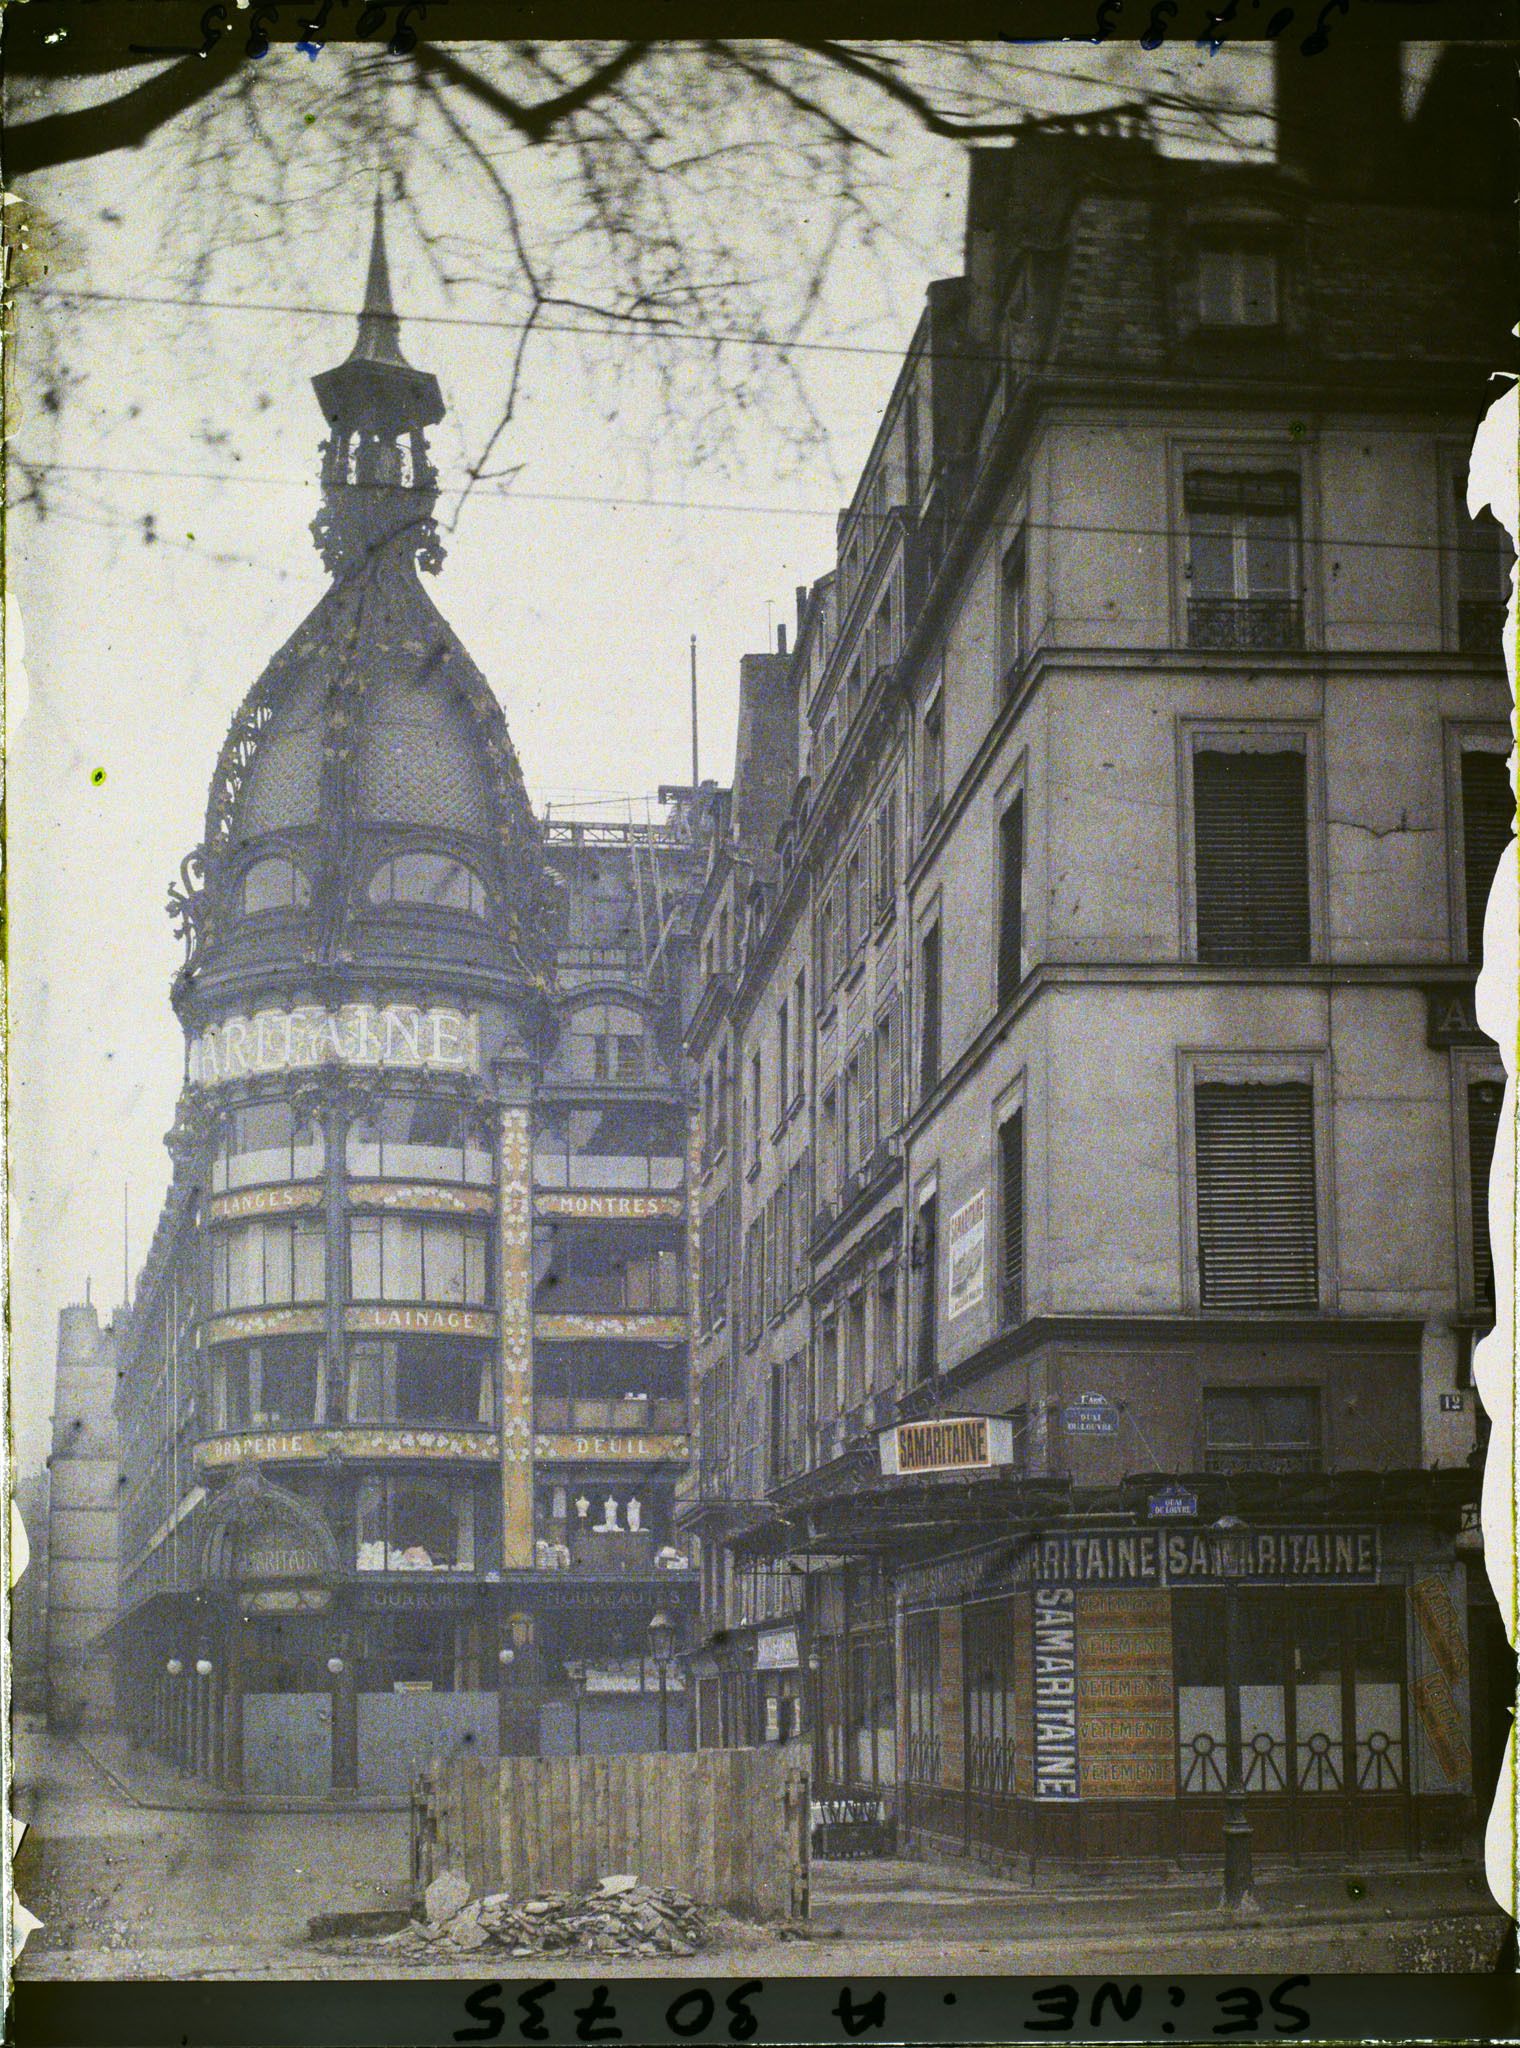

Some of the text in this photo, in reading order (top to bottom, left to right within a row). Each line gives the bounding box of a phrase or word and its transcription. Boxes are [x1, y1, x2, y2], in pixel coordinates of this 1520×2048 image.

[223, 1191, 294, 1213] LANGES
[559, 1198, 658, 1213] MONTRES
[375, 1311, 474, 1329] LAINAGE
[216, 1436, 301, 1457] DRAPERIE
[576, 1437, 649, 1454] DEUIL
[899, 1421, 986, 1467] SAMARITAINE
[1036, 1588, 1076, 1794] SAMARITAINE
[453, 1981, 622, 2041] 735
[832, 1987, 887, 2037] A
